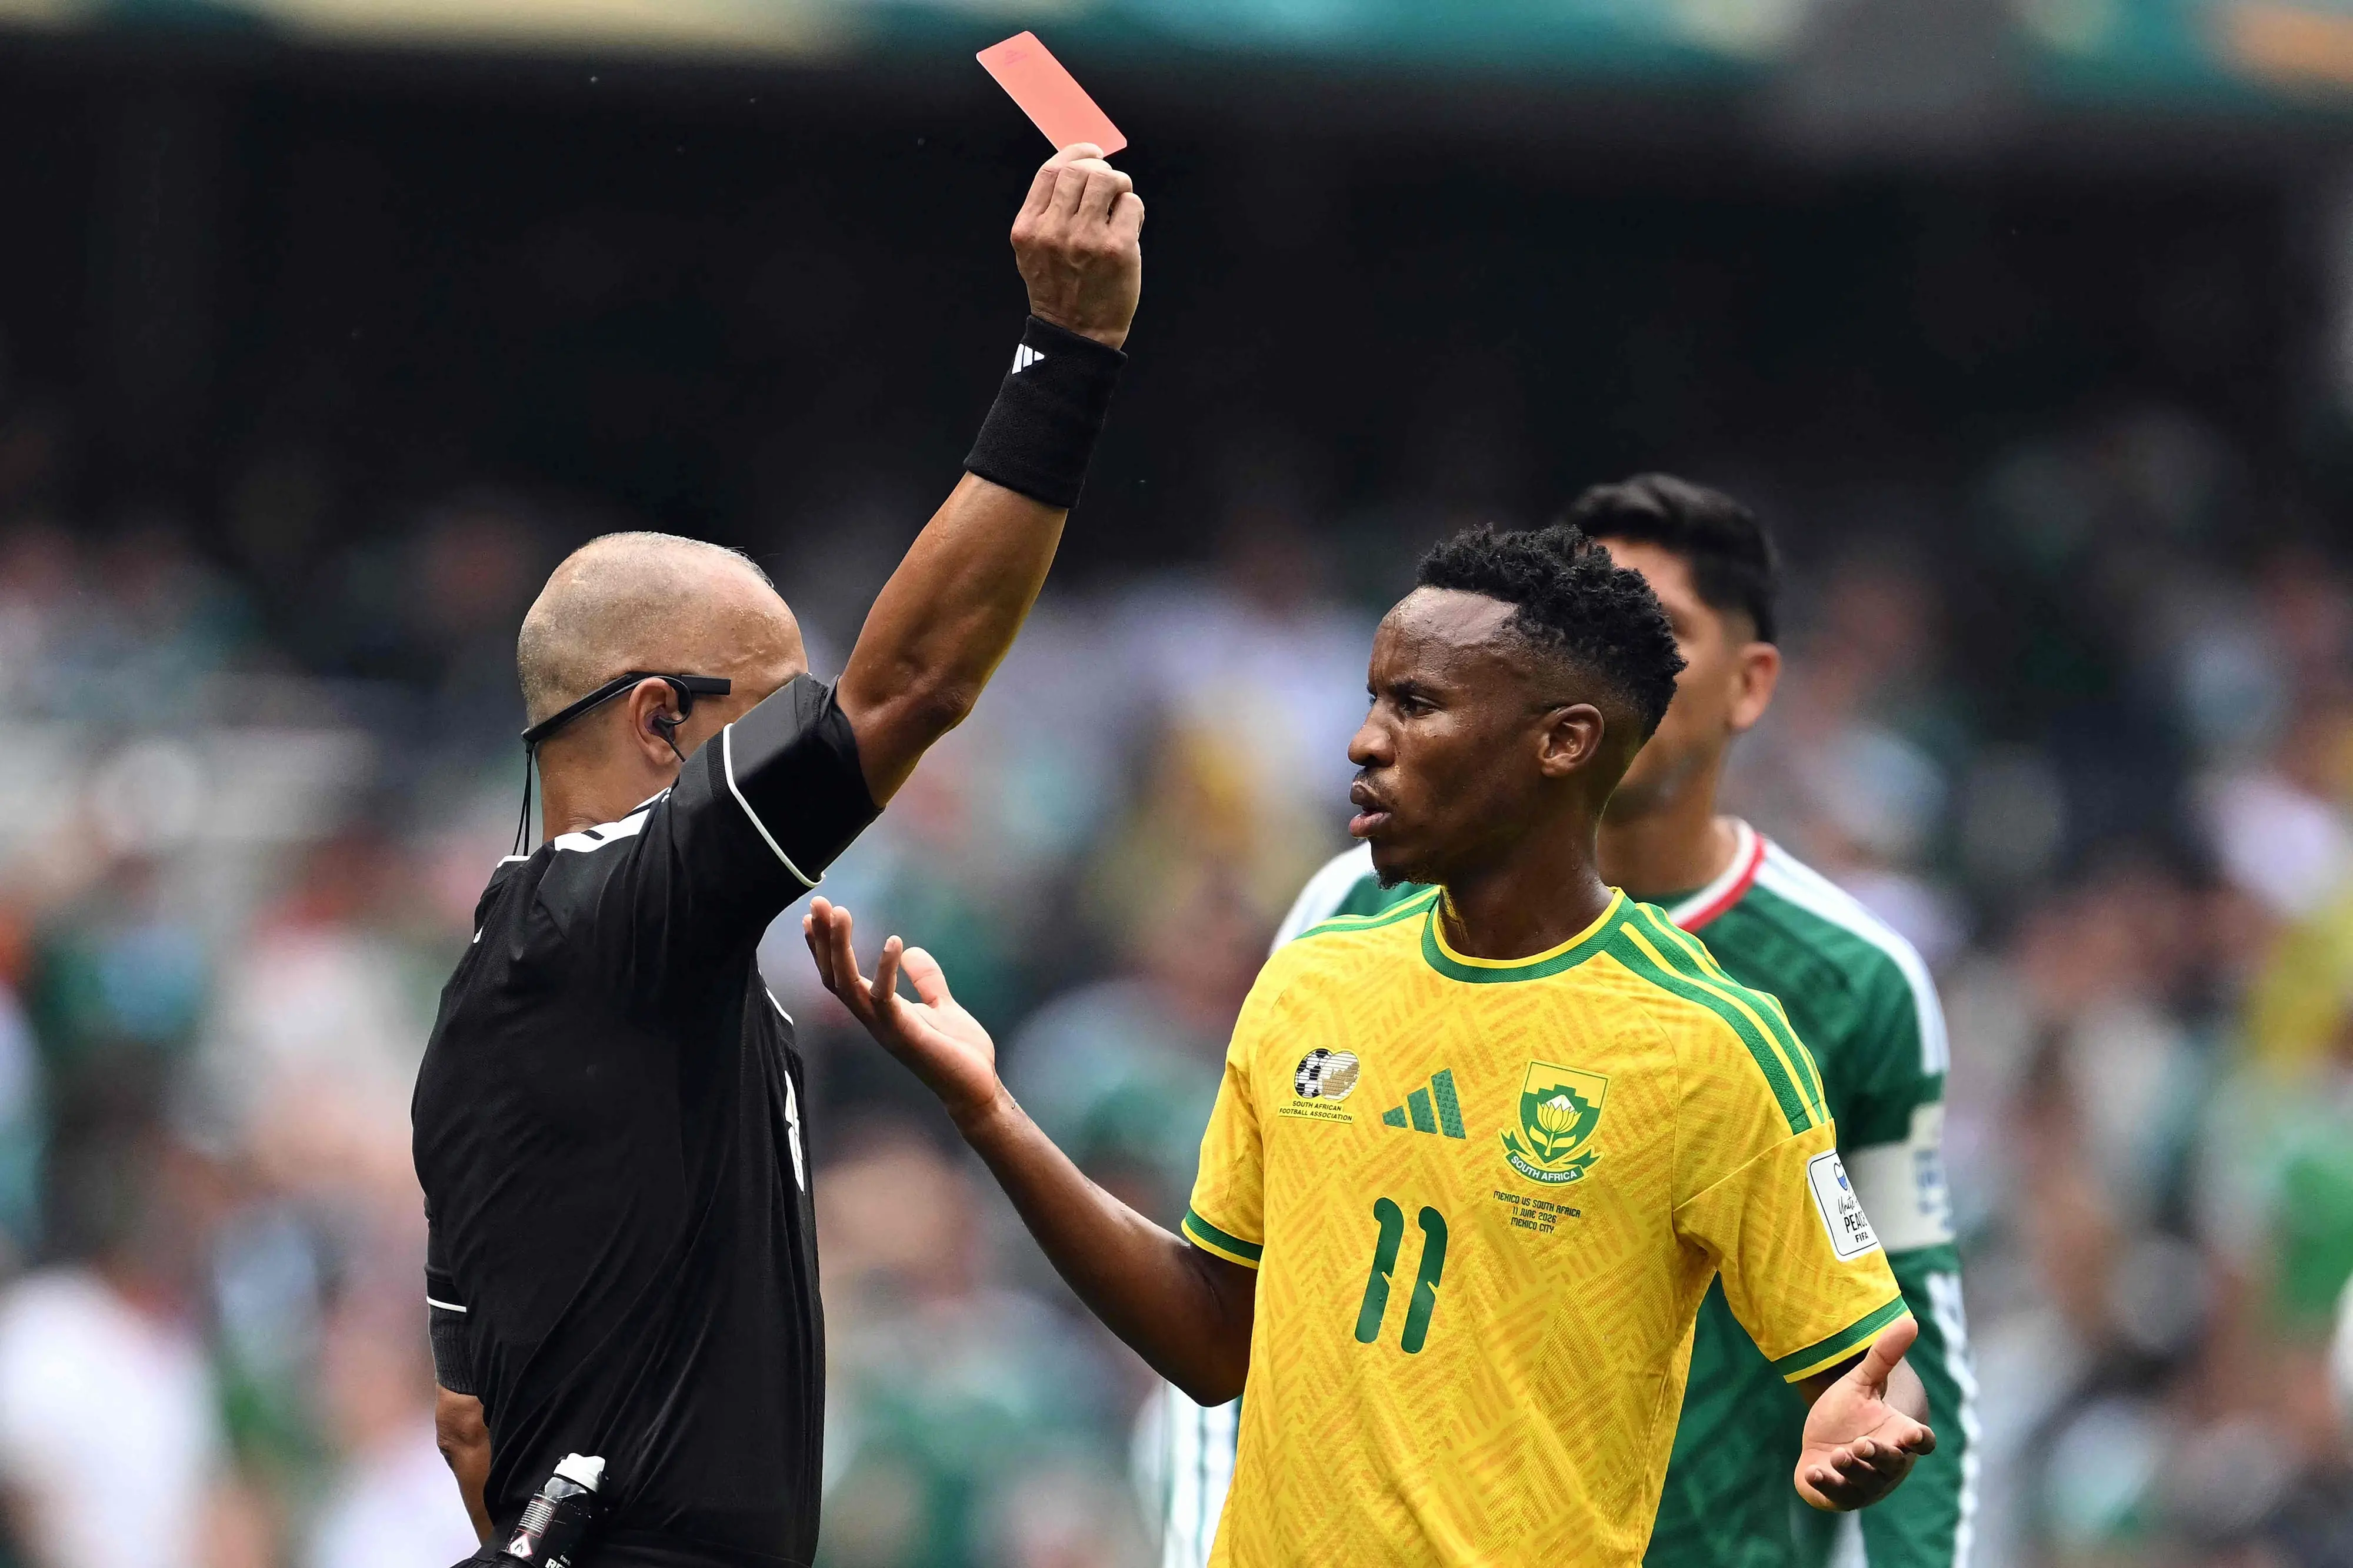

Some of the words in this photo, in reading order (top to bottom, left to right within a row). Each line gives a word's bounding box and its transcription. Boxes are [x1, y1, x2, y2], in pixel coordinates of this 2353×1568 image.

[1279, 1107, 1308, 1116] FOOTBALL
[1309, 1111, 1352, 1121] ASSOCIATION
[1314, 1103, 1342, 1111] AFRICAN
[1511, 1155, 1541, 1179] SOUTH
[1541, 1170, 1578, 1181] AFRICA
[1493, 1190, 1520, 1204] MEXICO
[1532, 1199, 1555, 1212] SOUTH
[1555, 1205, 1581, 1218] AFRICA
[1512, 1206, 1518, 1215] 11
[1519, 1207, 1537, 1219] JUNE
[1538, 1212, 1557, 1223] 2026
[1511, 1216, 1538, 1230] MEXICO
[1539, 1223, 1555, 1234] CITY
[1855, 1231, 1869, 1243] FIFA
[1354, 1196, 1448, 1354] 11
